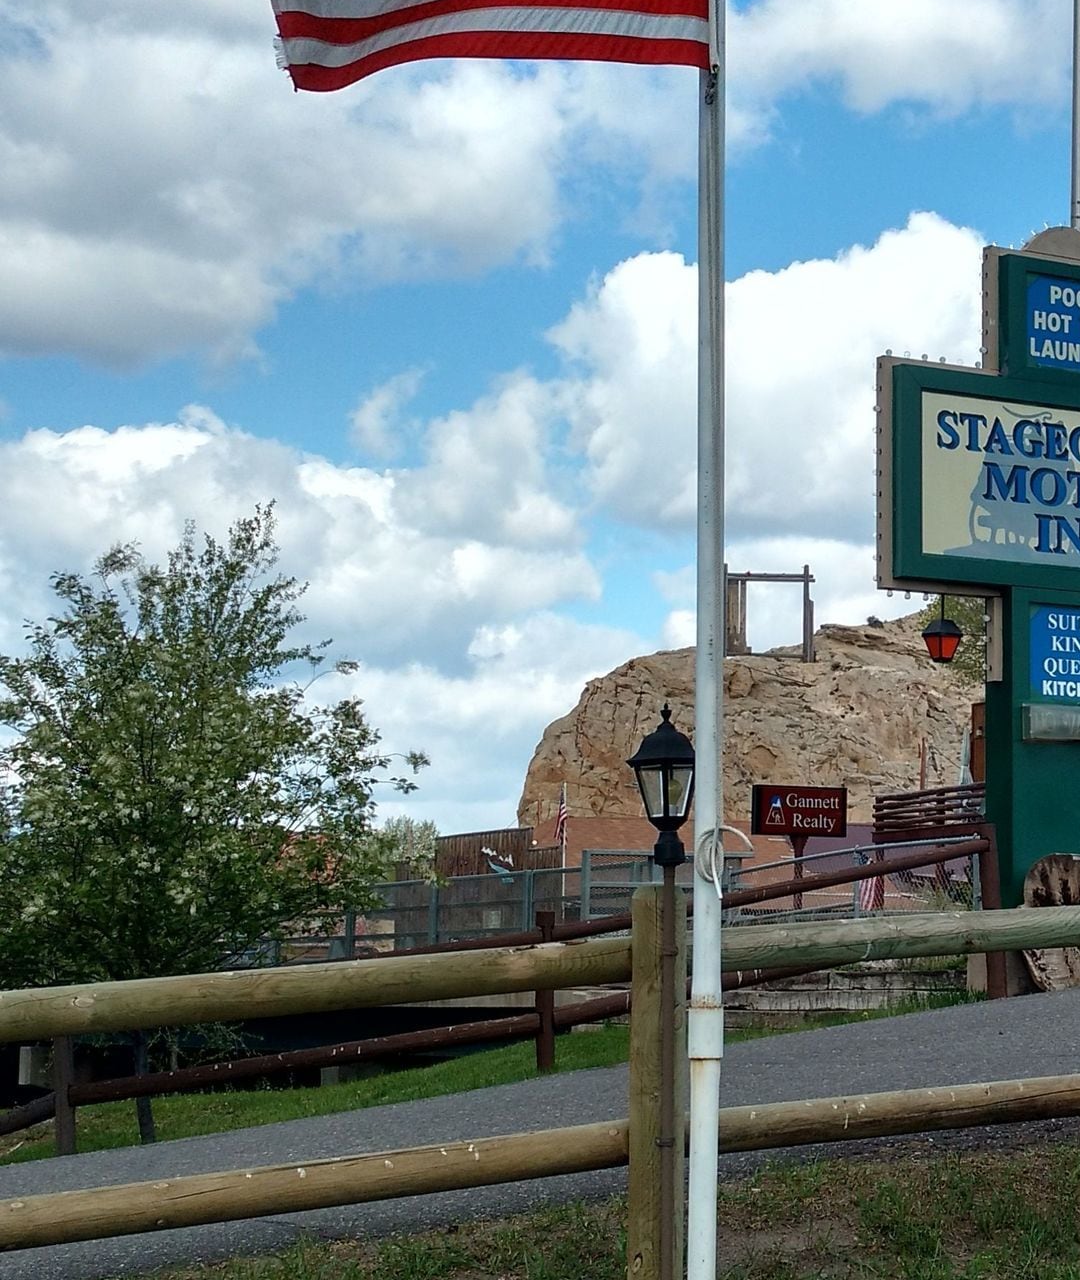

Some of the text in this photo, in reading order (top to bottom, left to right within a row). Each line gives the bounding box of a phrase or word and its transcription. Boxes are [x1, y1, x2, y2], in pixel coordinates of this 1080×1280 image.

[1034, 310, 1072, 334] HOT
[786, 793, 839, 809] Gannett
[792, 813, 836, 832] Realty
